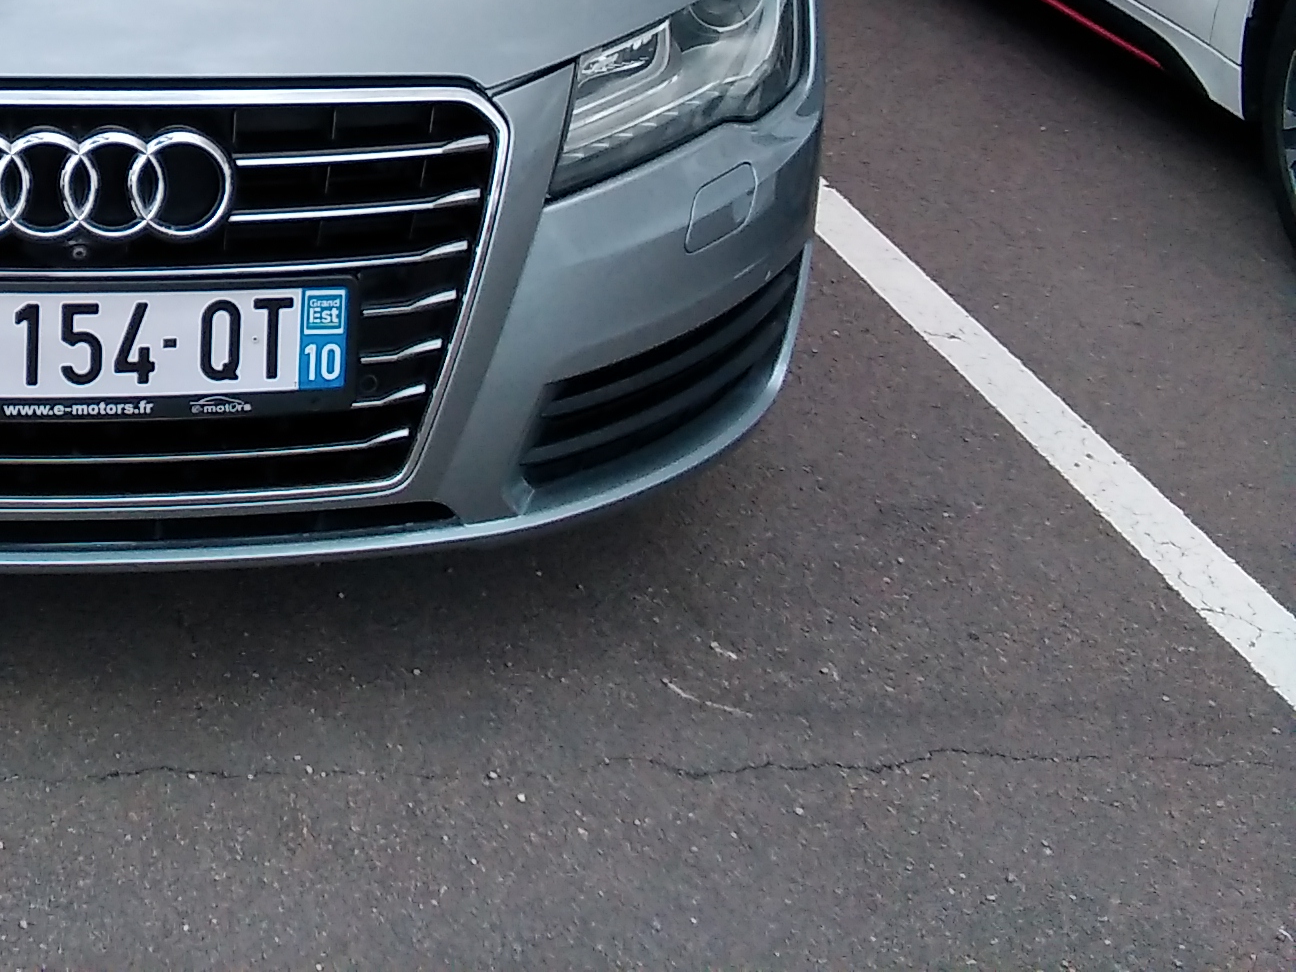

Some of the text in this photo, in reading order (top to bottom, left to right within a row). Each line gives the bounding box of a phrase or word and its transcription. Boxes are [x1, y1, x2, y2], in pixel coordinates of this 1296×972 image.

[309, 298, 341, 307] Grand
[309, 307, 339, 323] Est
[304, 343, 341, 381] 10
[3, 400, 154, 416] www.e-motors.fr
